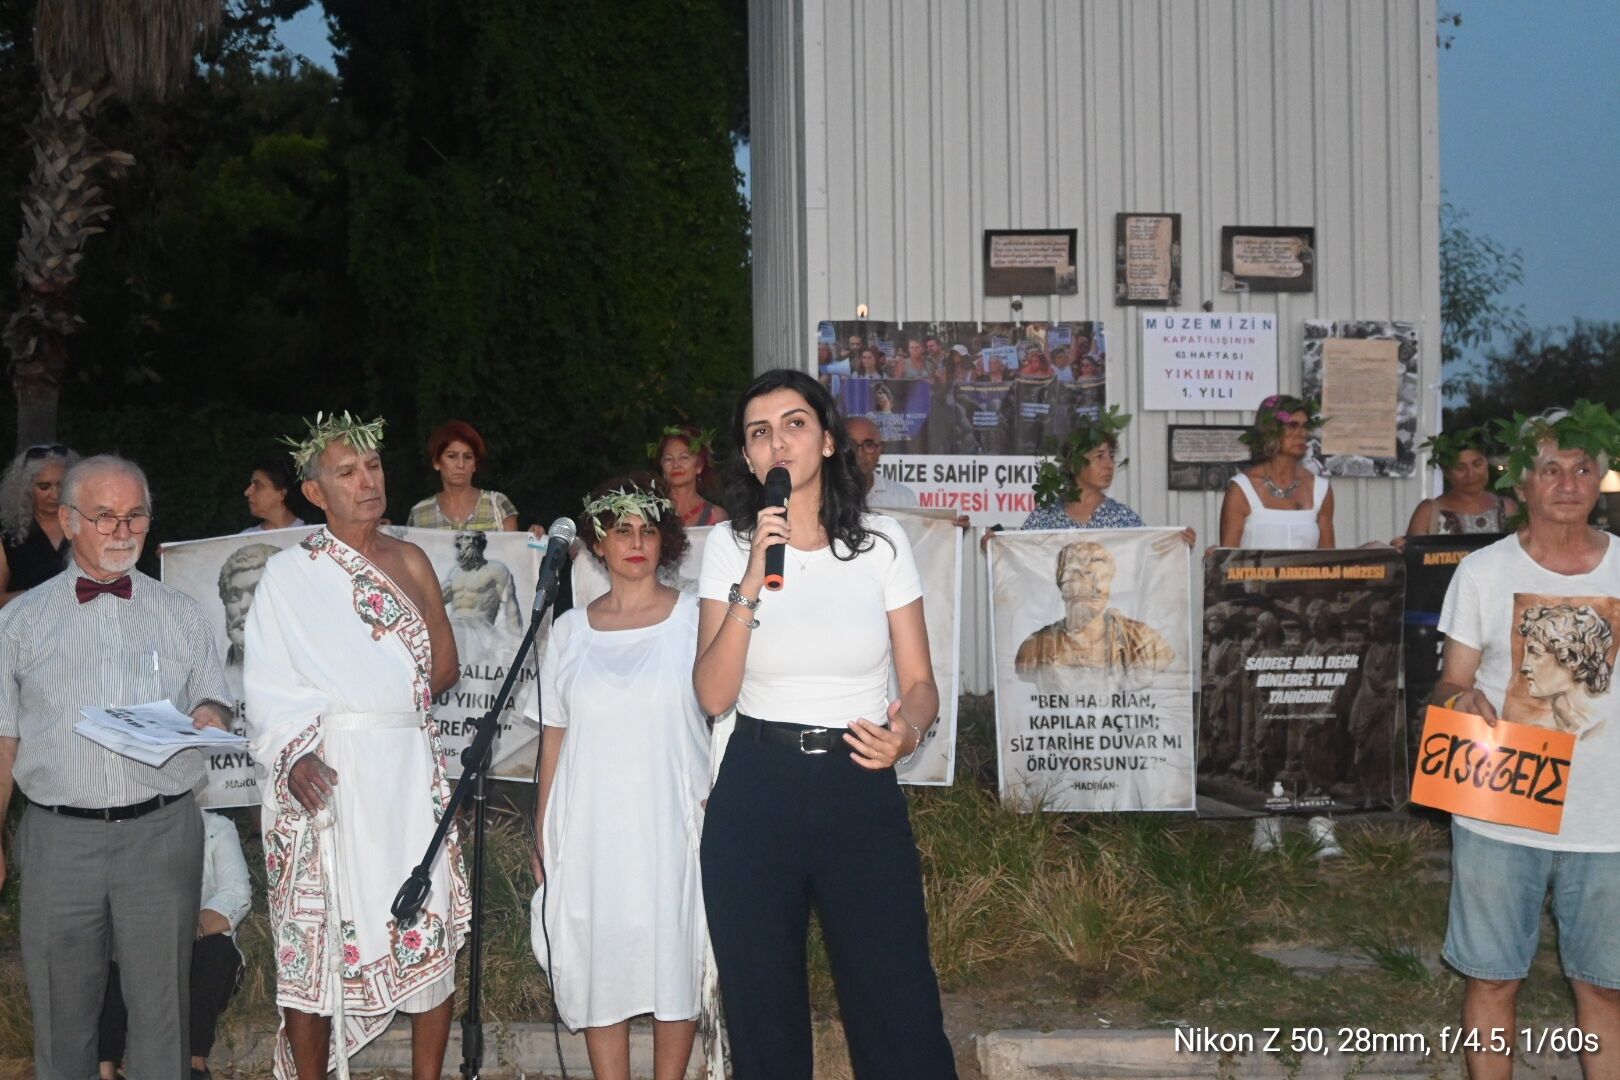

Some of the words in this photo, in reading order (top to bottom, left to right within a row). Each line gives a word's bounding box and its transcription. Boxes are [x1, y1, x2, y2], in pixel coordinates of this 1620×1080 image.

[1146, 316, 1272, 330] MÜZEMİZİN
[1163, 335, 1255, 345] KAPATILIŞININ
[1190, 351, 1244, 360] HAFTASI
[1165, 368, 1254, 381] YIKIMININ
[1182, 388, 1192, 398] 1.
[1199, 387, 1233, 398] YILI
[933, 459, 989, 483] SAHİP
[919, 488, 989, 512] MÜZESİ
[1228, 567, 1276, 579] ANTALYA
[1245, 656, 1294, 670] SADECE
[1256, 672, 1315, 687] BİNLERCE
[1316, 672, 1348, 686] YILIN
[1031, 694, 1069, 709] "BEN
[1029, 715, 1096, 730] KAPILAR
[1102, 714, 1160, 732] AÇTIM;
[1010, 734, 1034, 752] SİZ
[1038, 733, 1095, 750] TARİHE
[1100, 735, 1158, 750] DUVAR
[1163, 735, 1182, 749] MI
